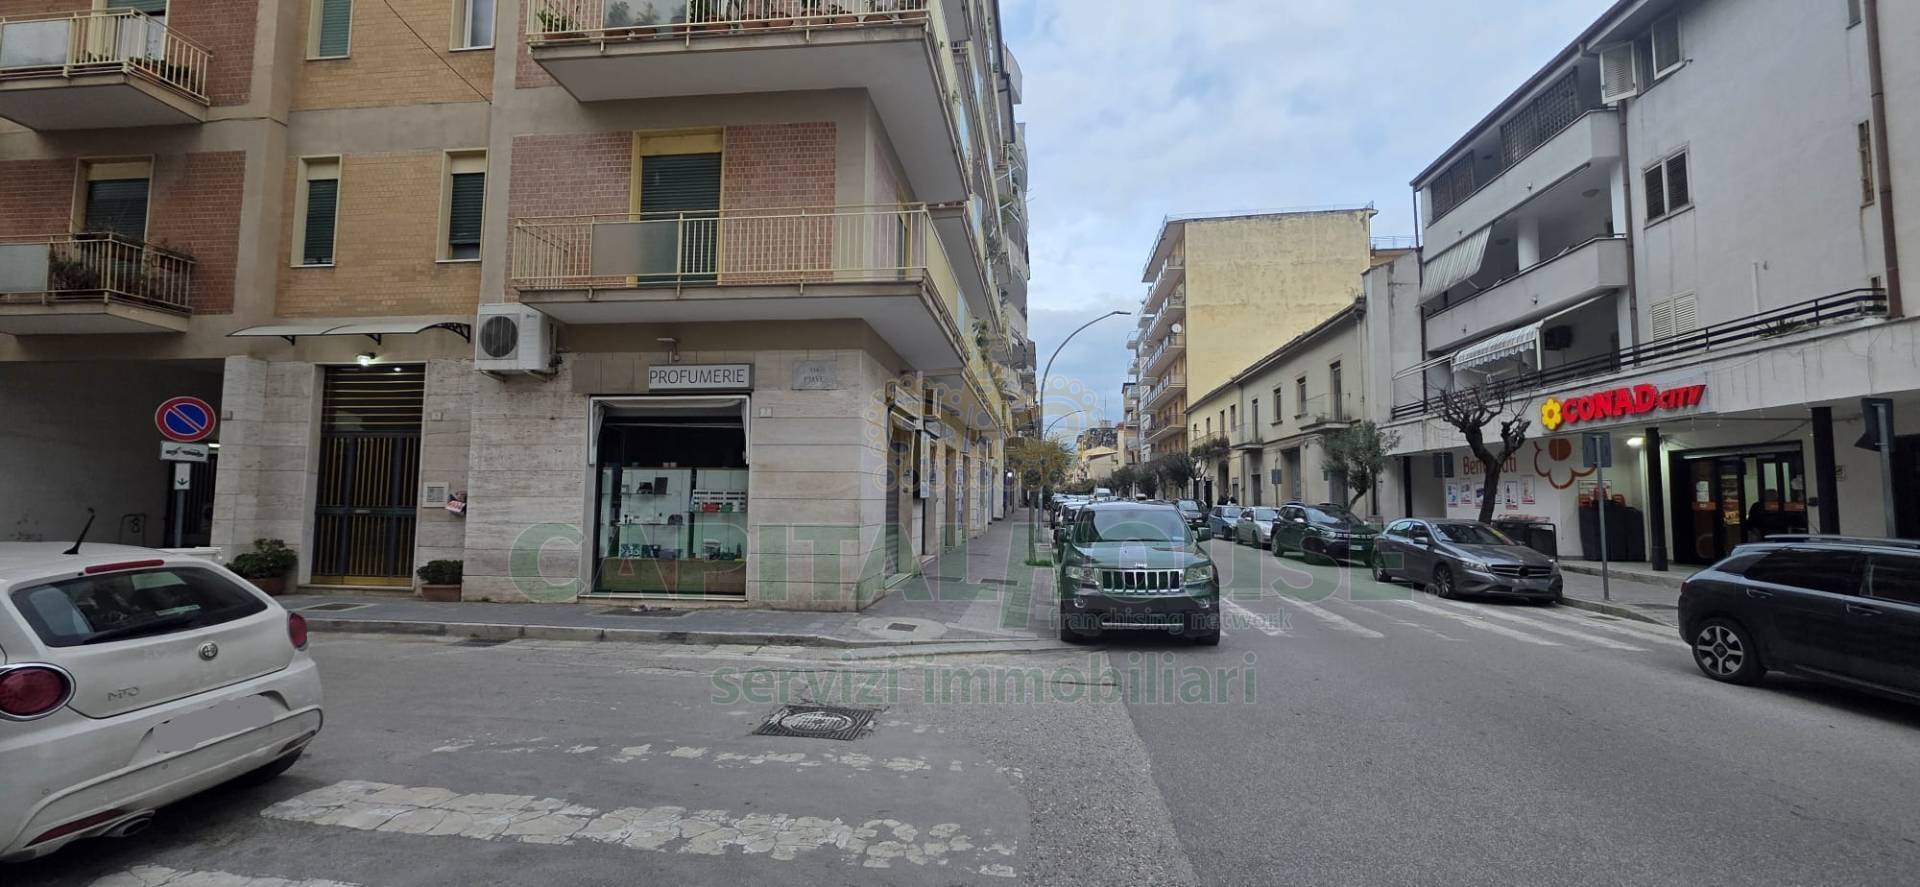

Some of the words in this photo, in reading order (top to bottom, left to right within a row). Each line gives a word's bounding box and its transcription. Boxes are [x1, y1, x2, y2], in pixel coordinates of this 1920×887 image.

[649, 368, 745, 385] PROFUMERIE
[1561, 383, 1659, 424] CONAD
[1659, 384, 1707, 410] CITY
[1463, 452, 1517, 475] Benuti
